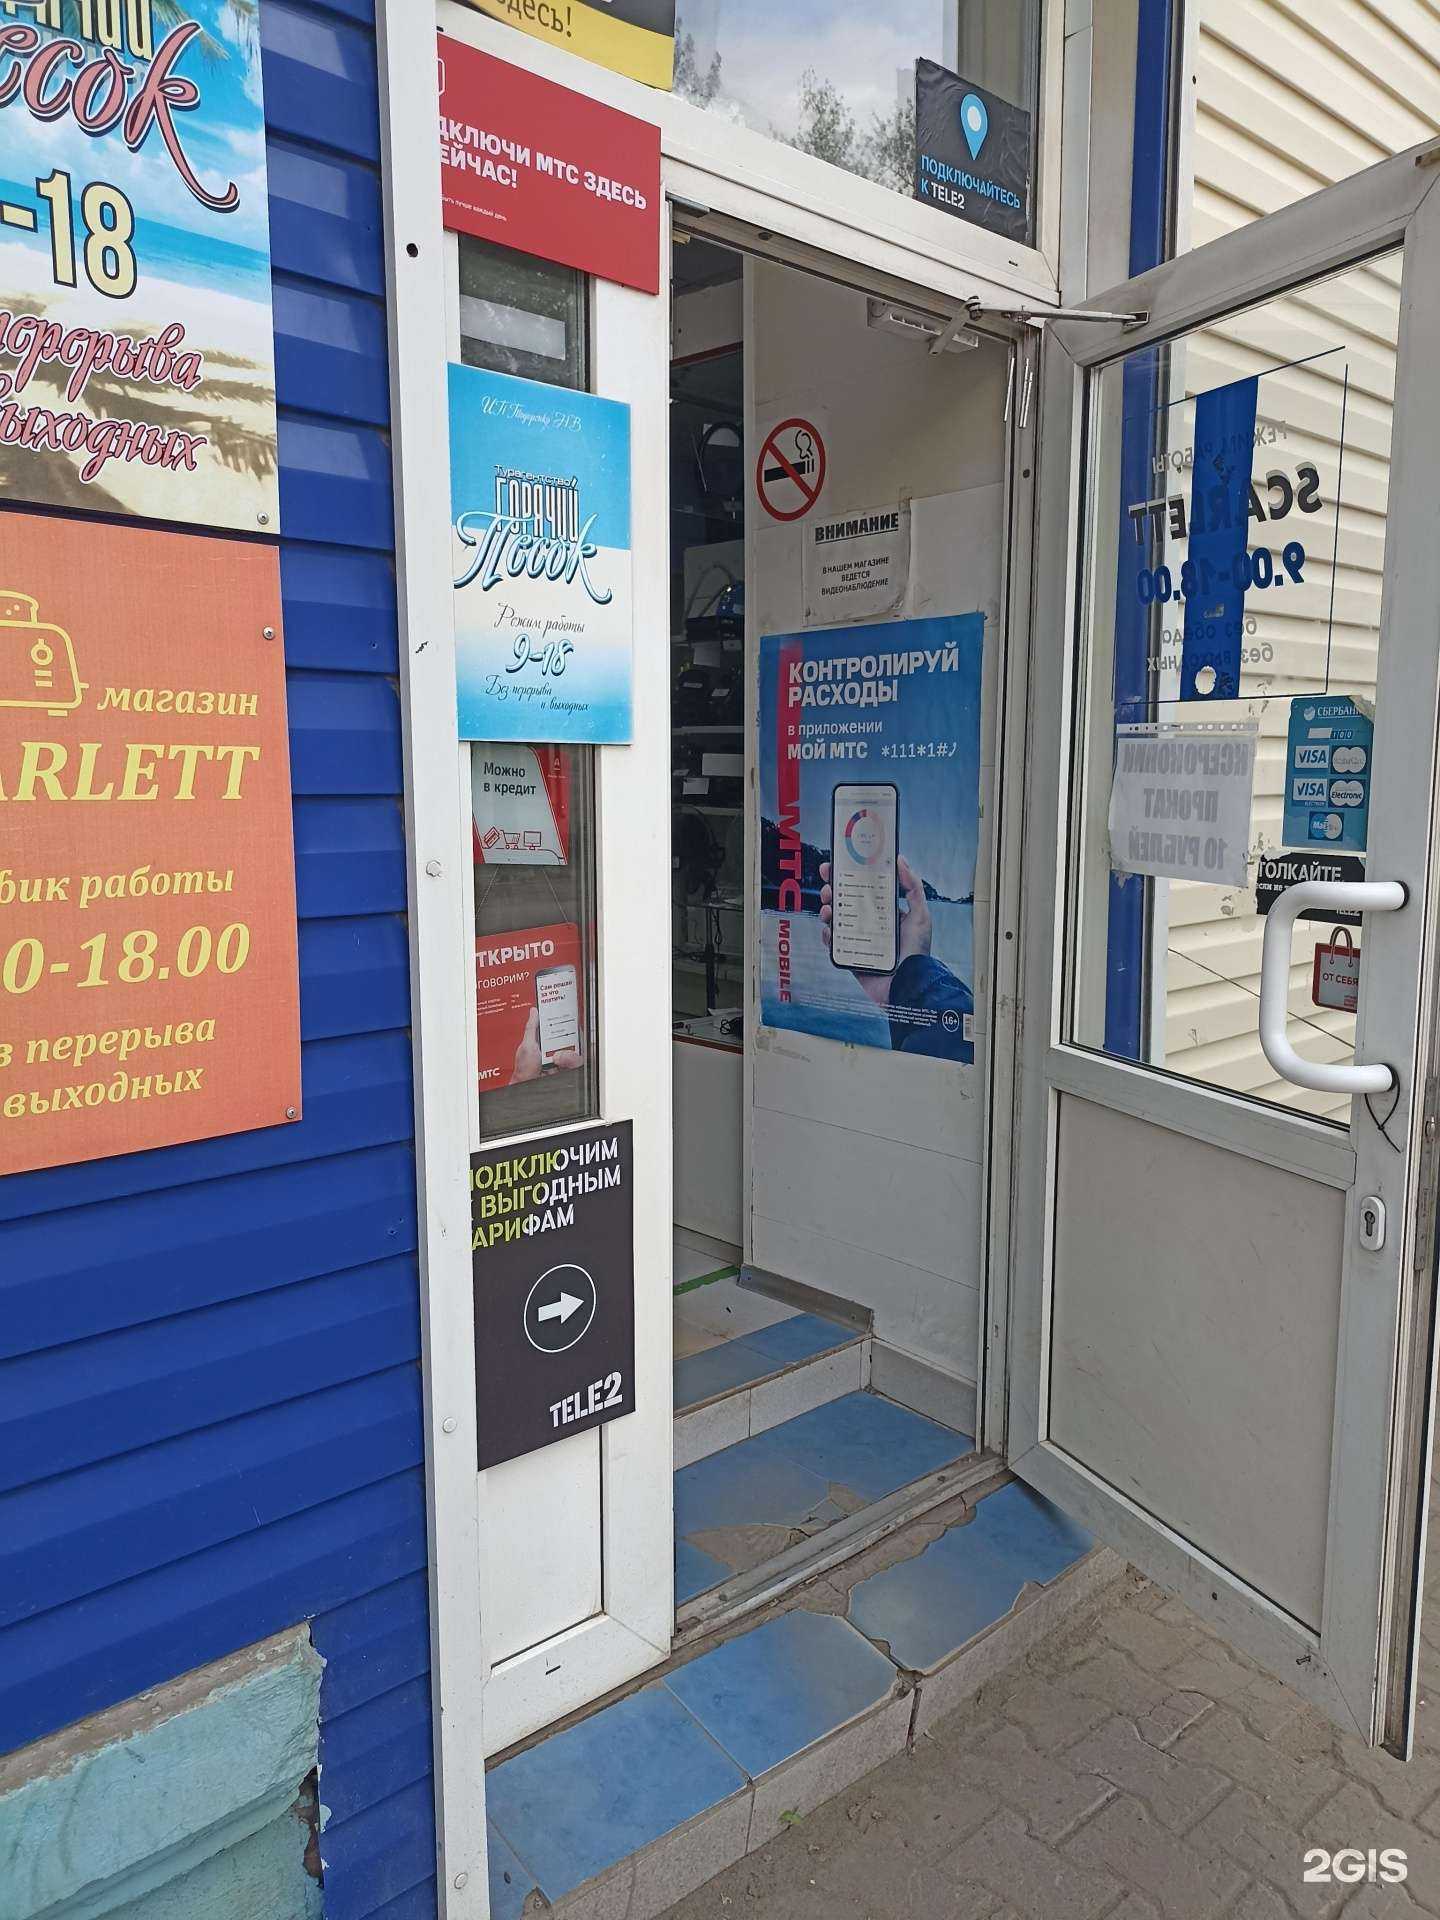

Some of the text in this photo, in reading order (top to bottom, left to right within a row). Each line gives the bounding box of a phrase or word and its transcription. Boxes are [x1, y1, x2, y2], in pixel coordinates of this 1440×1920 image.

[497, 0, 572, 37] десь!
[536, 151, 580, 185] МТС
[583, 171, 648, 211] ЗДЕСЬ
[921, 155, 1021, 209] ПОДКЛЮЧАЙТЕСЬ
[931, 182, 965, 210] TELE2
[0, 311, 202, 402] ерерыва
[494, 465, 571, 487] Турагентство
[815, 513, 899, 543] ВНИМАНИЕ
[821, 577, 889, 595] ВИДЕОНАБЛЮДЕНИЕ
[841, 570, 870, 582] ВЕДЕТСЯ
[494, 602, 586, 638] Режим работы
[505, 633, 574, 676] 9-18
[789, 641, 959, 684] КОНТРОЛИРУЙ
[97, 687, 258, 716] магазин
[788, 680, 898, 707] РАСХОДЫ
[798, 720, 883, 738] приложении
[787, 738, 826, 760] МОЙ
[830, 741, 868, 759] МТС
[1299, 749, 1327, 764] VISA
[0, 741, 261, 801] RLETT
[484, 761, 526, 778] Можно
[483, 782, 537, 796] в кредит
[1297, 782, 1325, 796] VISA
[1331, 790, 1362, 800] Electronic
[1258, 860, 1342, 883] ТОЛКАЙТЕ
[79, 865, 234, 909] работы
[778, 918, 792, 1004] MOBILE
[942, 1014, 958, 1027] 16+
[26, 1018, 216, 1067] перерыва
[3, 1068, 205, 1118] выходных
[480, 1164, 622, 1220] ВЫГОДНЫМ
[549, 1371, 623, 1429] TELE2
